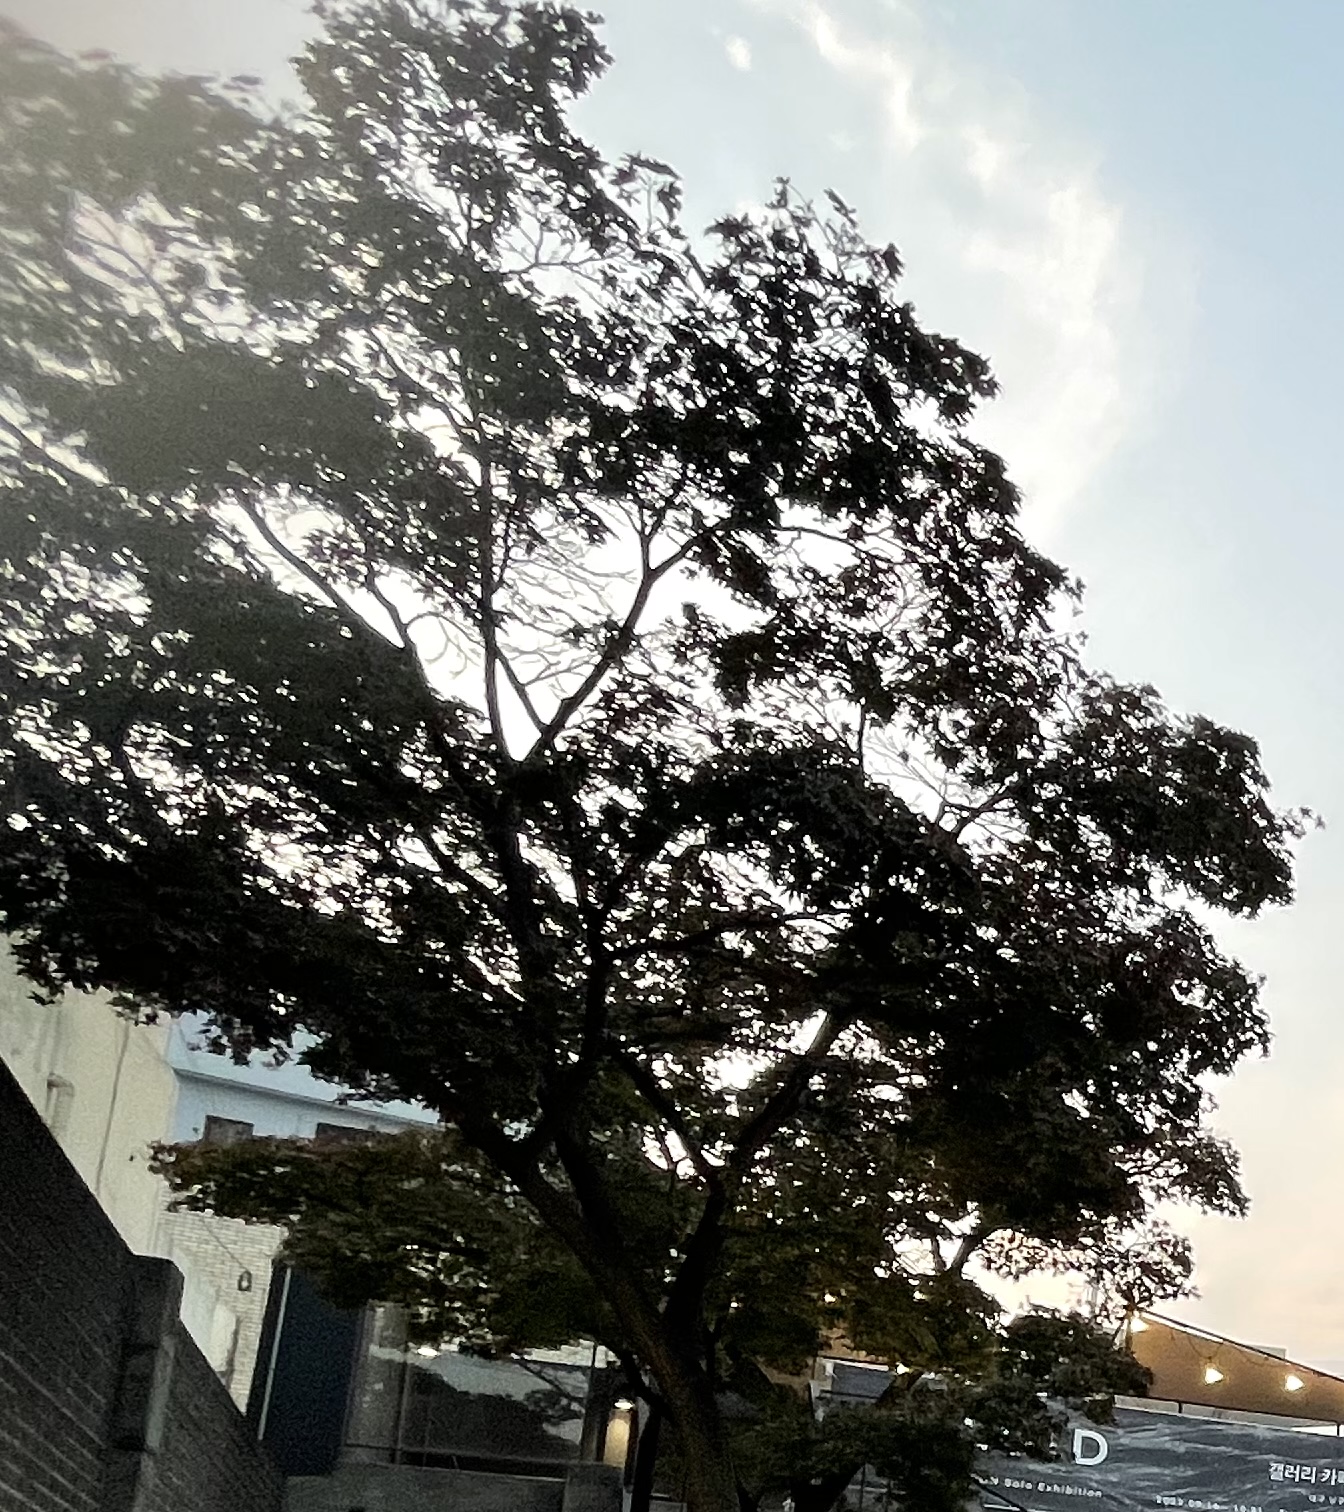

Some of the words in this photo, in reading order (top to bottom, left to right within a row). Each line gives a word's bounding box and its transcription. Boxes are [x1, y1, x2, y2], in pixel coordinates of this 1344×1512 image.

[1269, 1462, 1317, 1484] 갤러리
[1004, 1477, 1033, 1490] Solo
[1037, 1481, 1103, 1499] Exhibition
